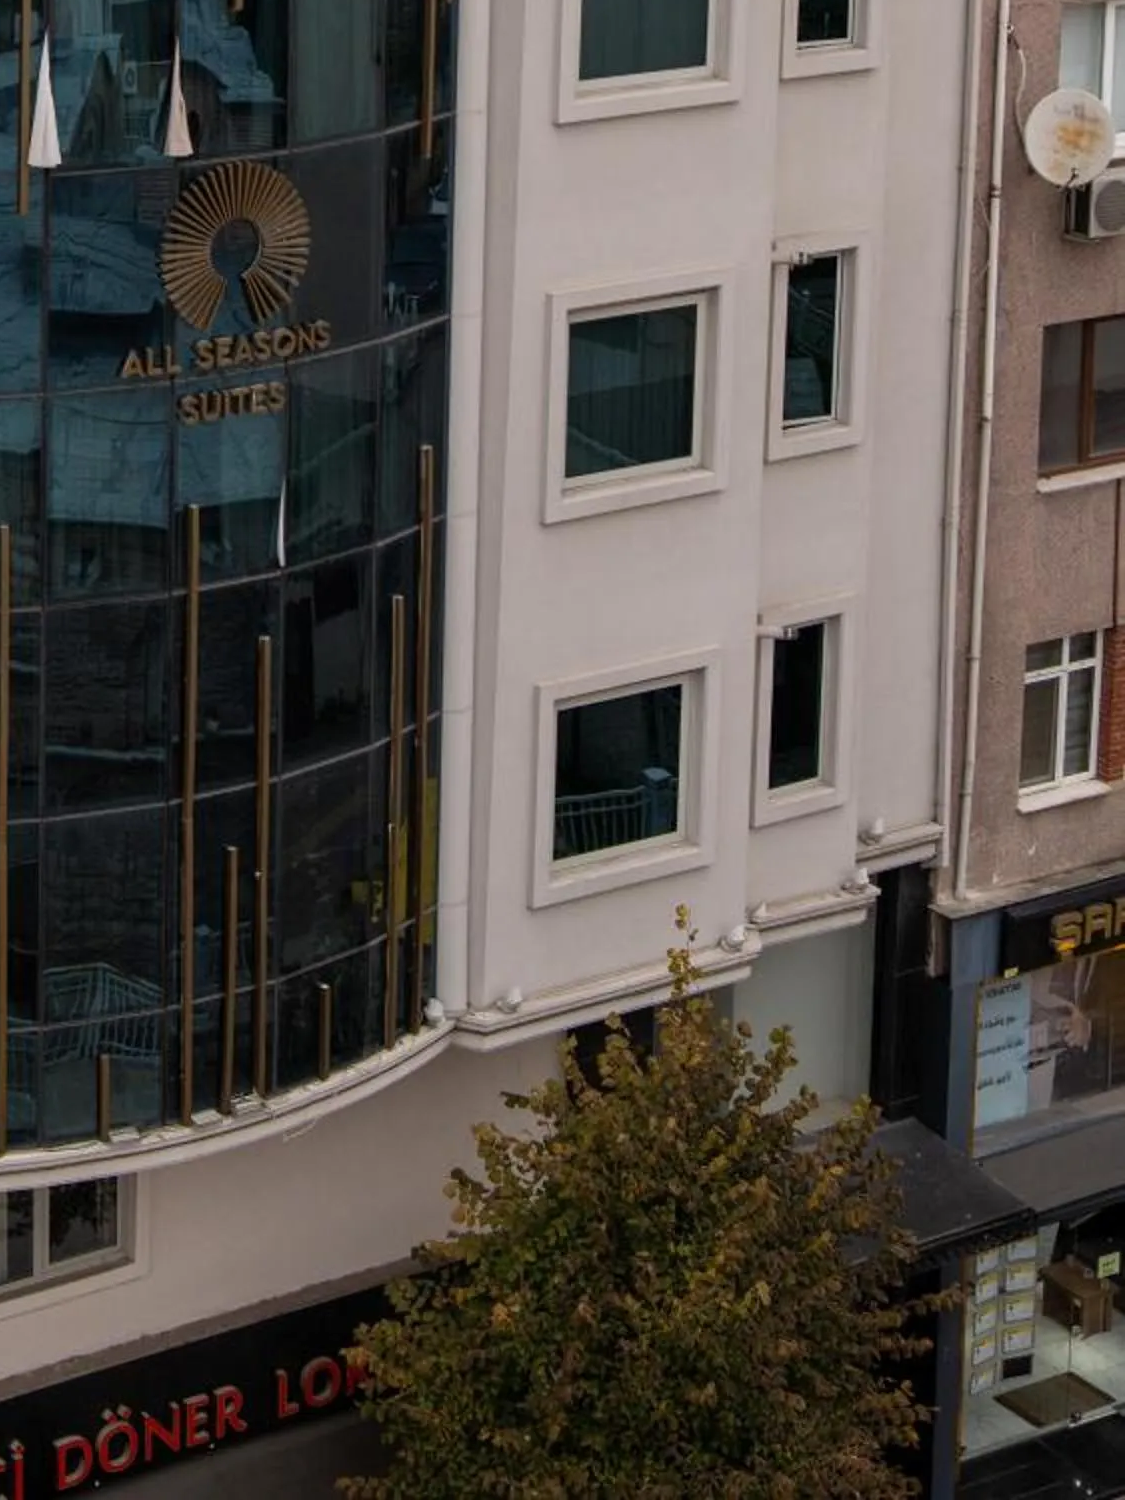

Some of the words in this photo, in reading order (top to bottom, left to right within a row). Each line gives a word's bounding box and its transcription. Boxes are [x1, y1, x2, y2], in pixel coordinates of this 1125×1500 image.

[121, 345, 181, 379] ALL
[195, 319, 331, 371] SEASONS
[178, 380, 286, 426] SUITES
[53, 1385, 248, 1491] DÖNER
